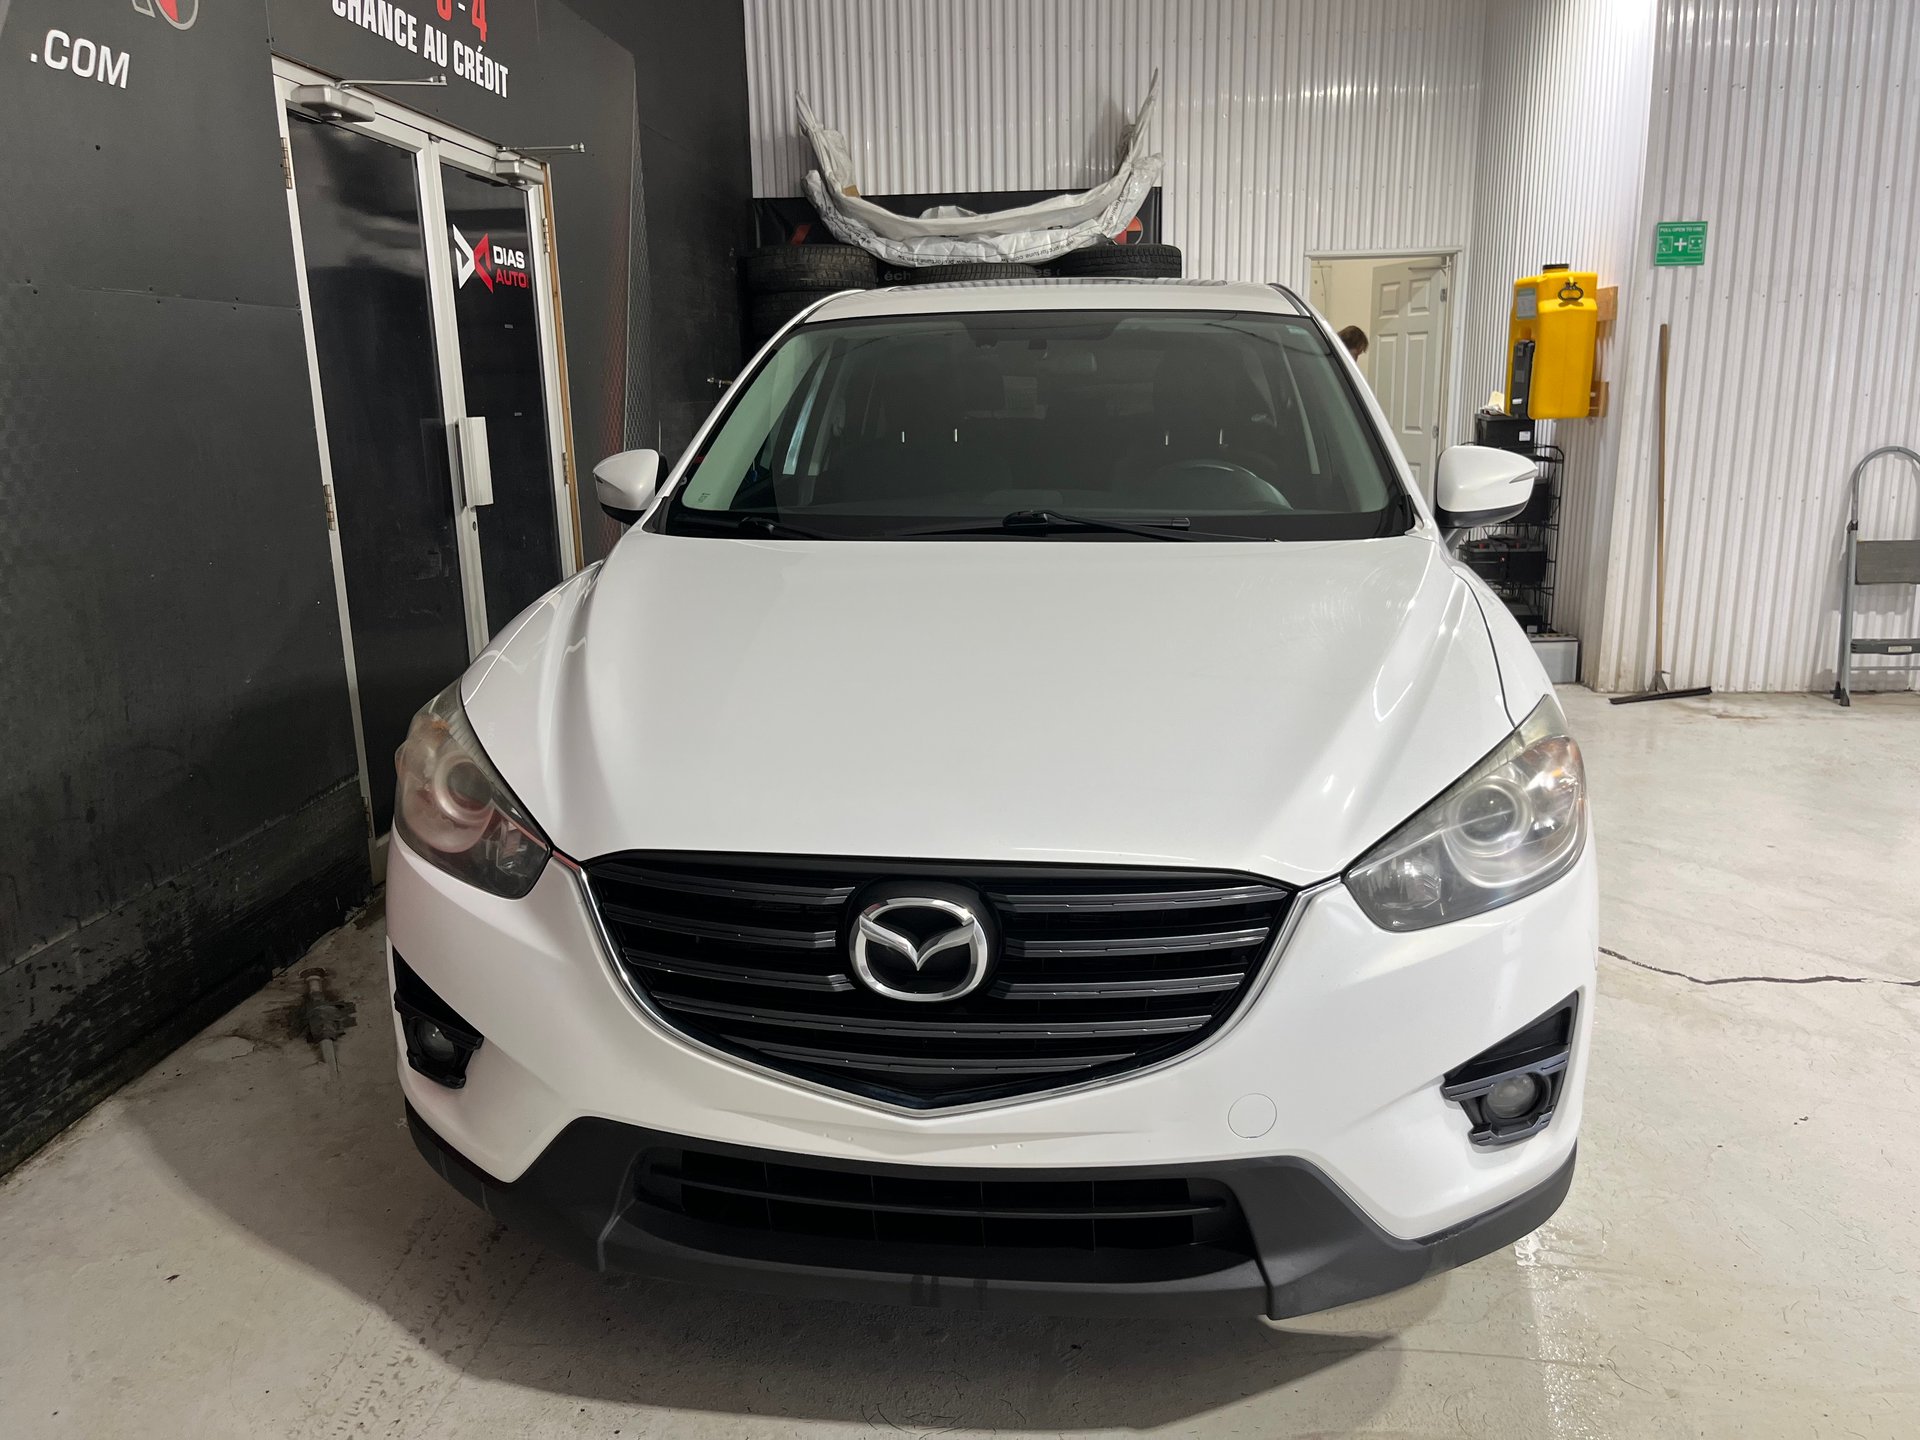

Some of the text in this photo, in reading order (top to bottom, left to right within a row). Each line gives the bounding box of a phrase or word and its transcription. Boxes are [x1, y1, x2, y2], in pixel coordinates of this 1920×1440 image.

[471, 0, 487, 43] 4
[30, 29, 130, 89] .COM
[423, 24, 448, 68] AU
[453, 40, 509, 98] CRÉDIT
[492, 245, 525, 269] DIAS
[496, 268, 528, 289] AUTO
